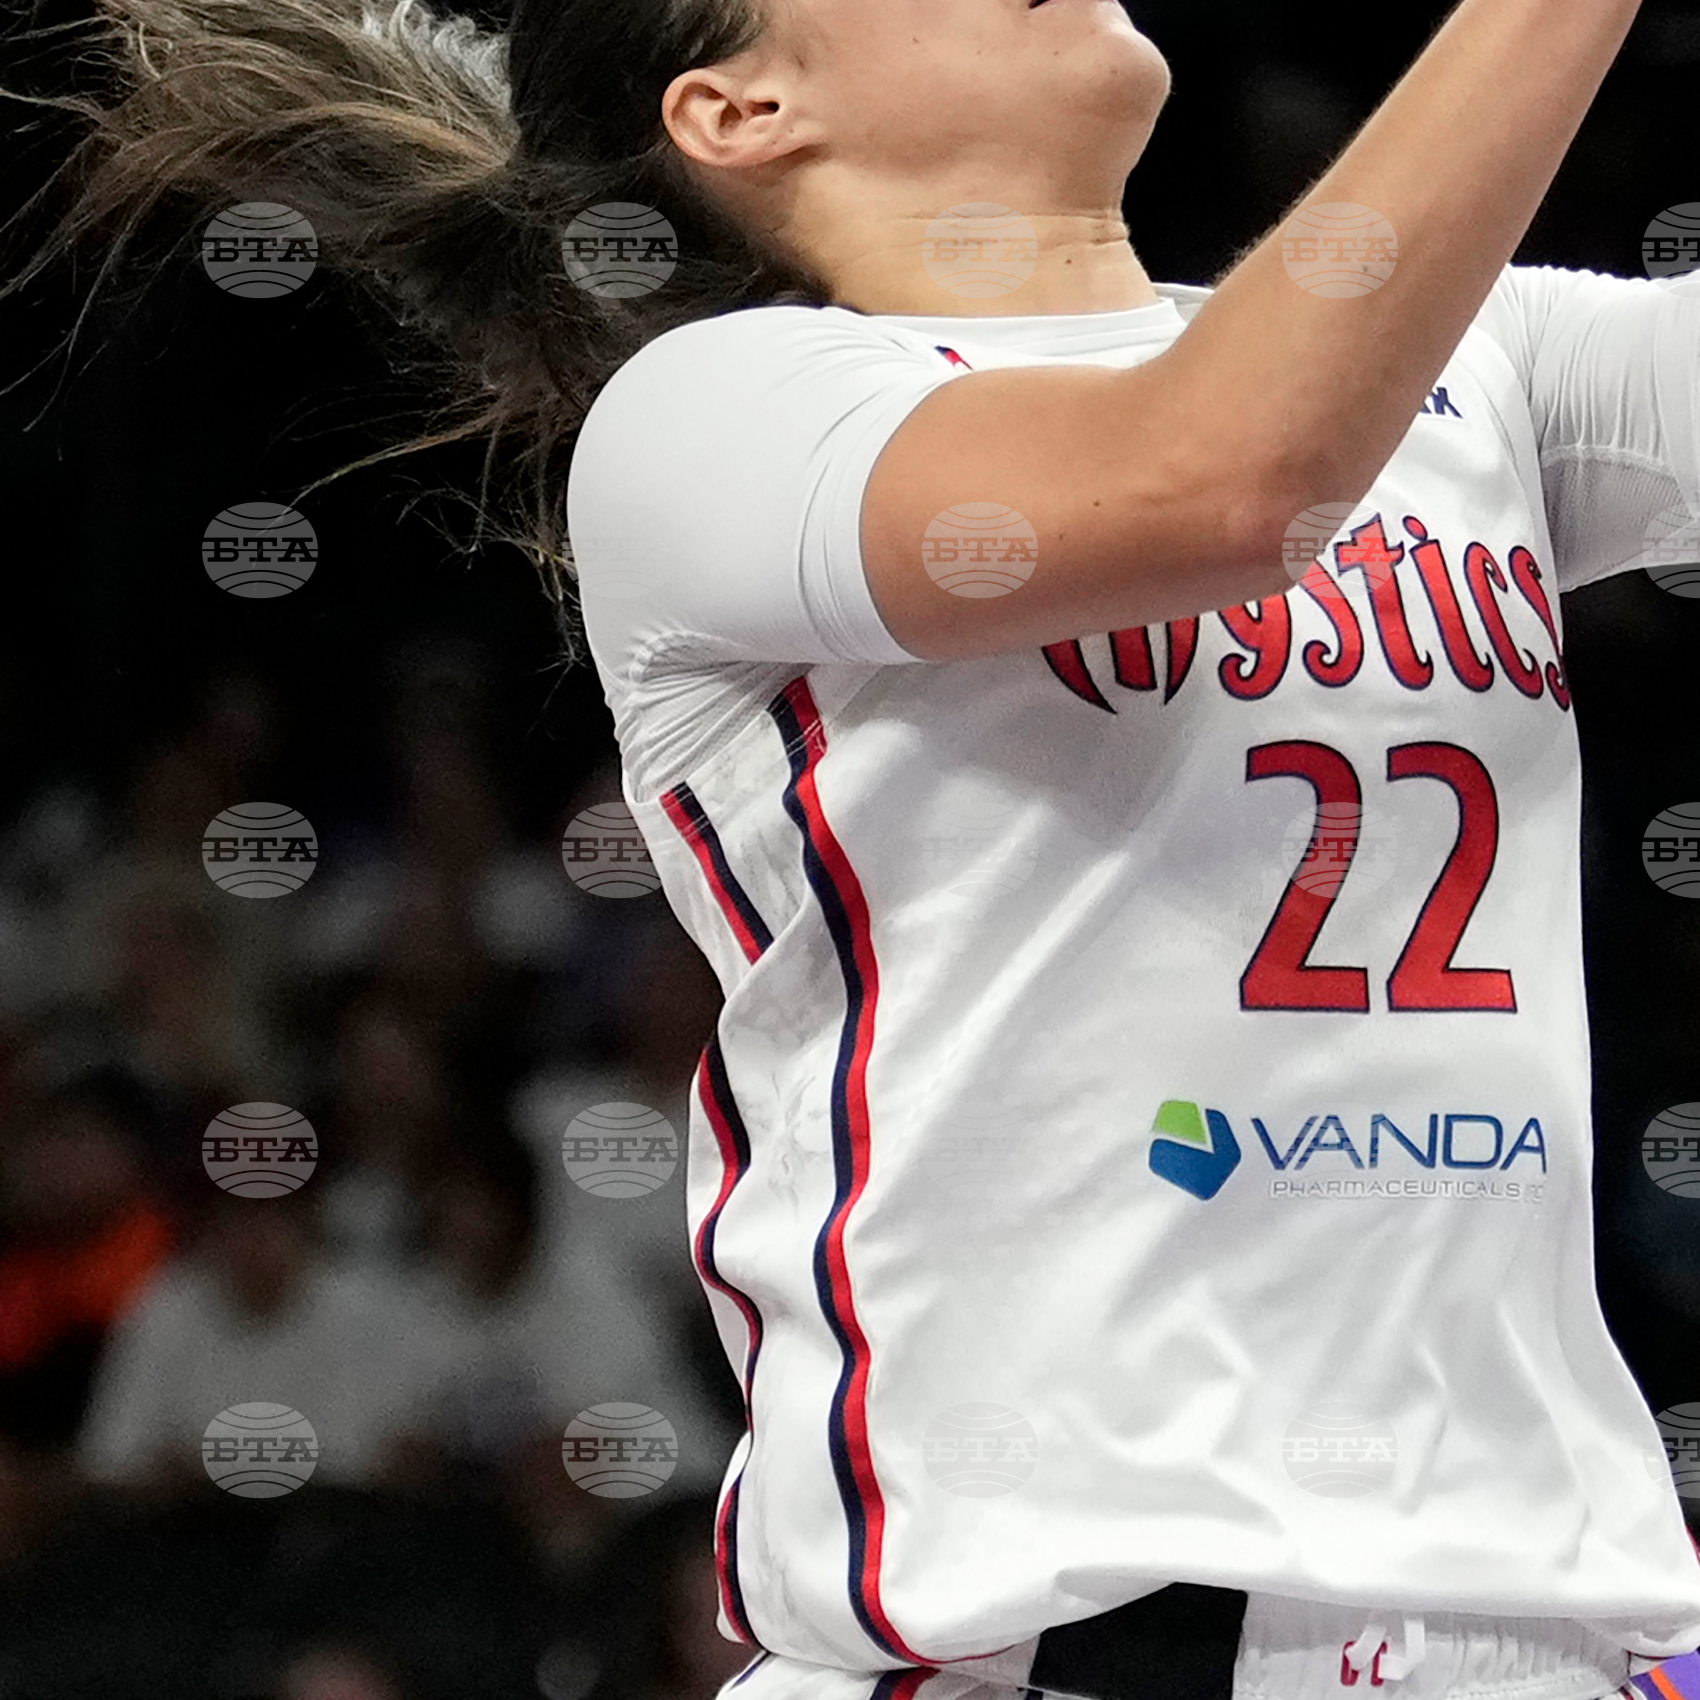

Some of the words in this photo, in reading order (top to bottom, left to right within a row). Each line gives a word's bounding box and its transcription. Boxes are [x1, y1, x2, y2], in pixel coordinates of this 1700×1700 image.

[1239, 740, 1519, 1014] 22
[1250, 1112, 1547, 1175] VANDA
[1272, 1180, 1521, 1198] PHARMACEUTICALS
